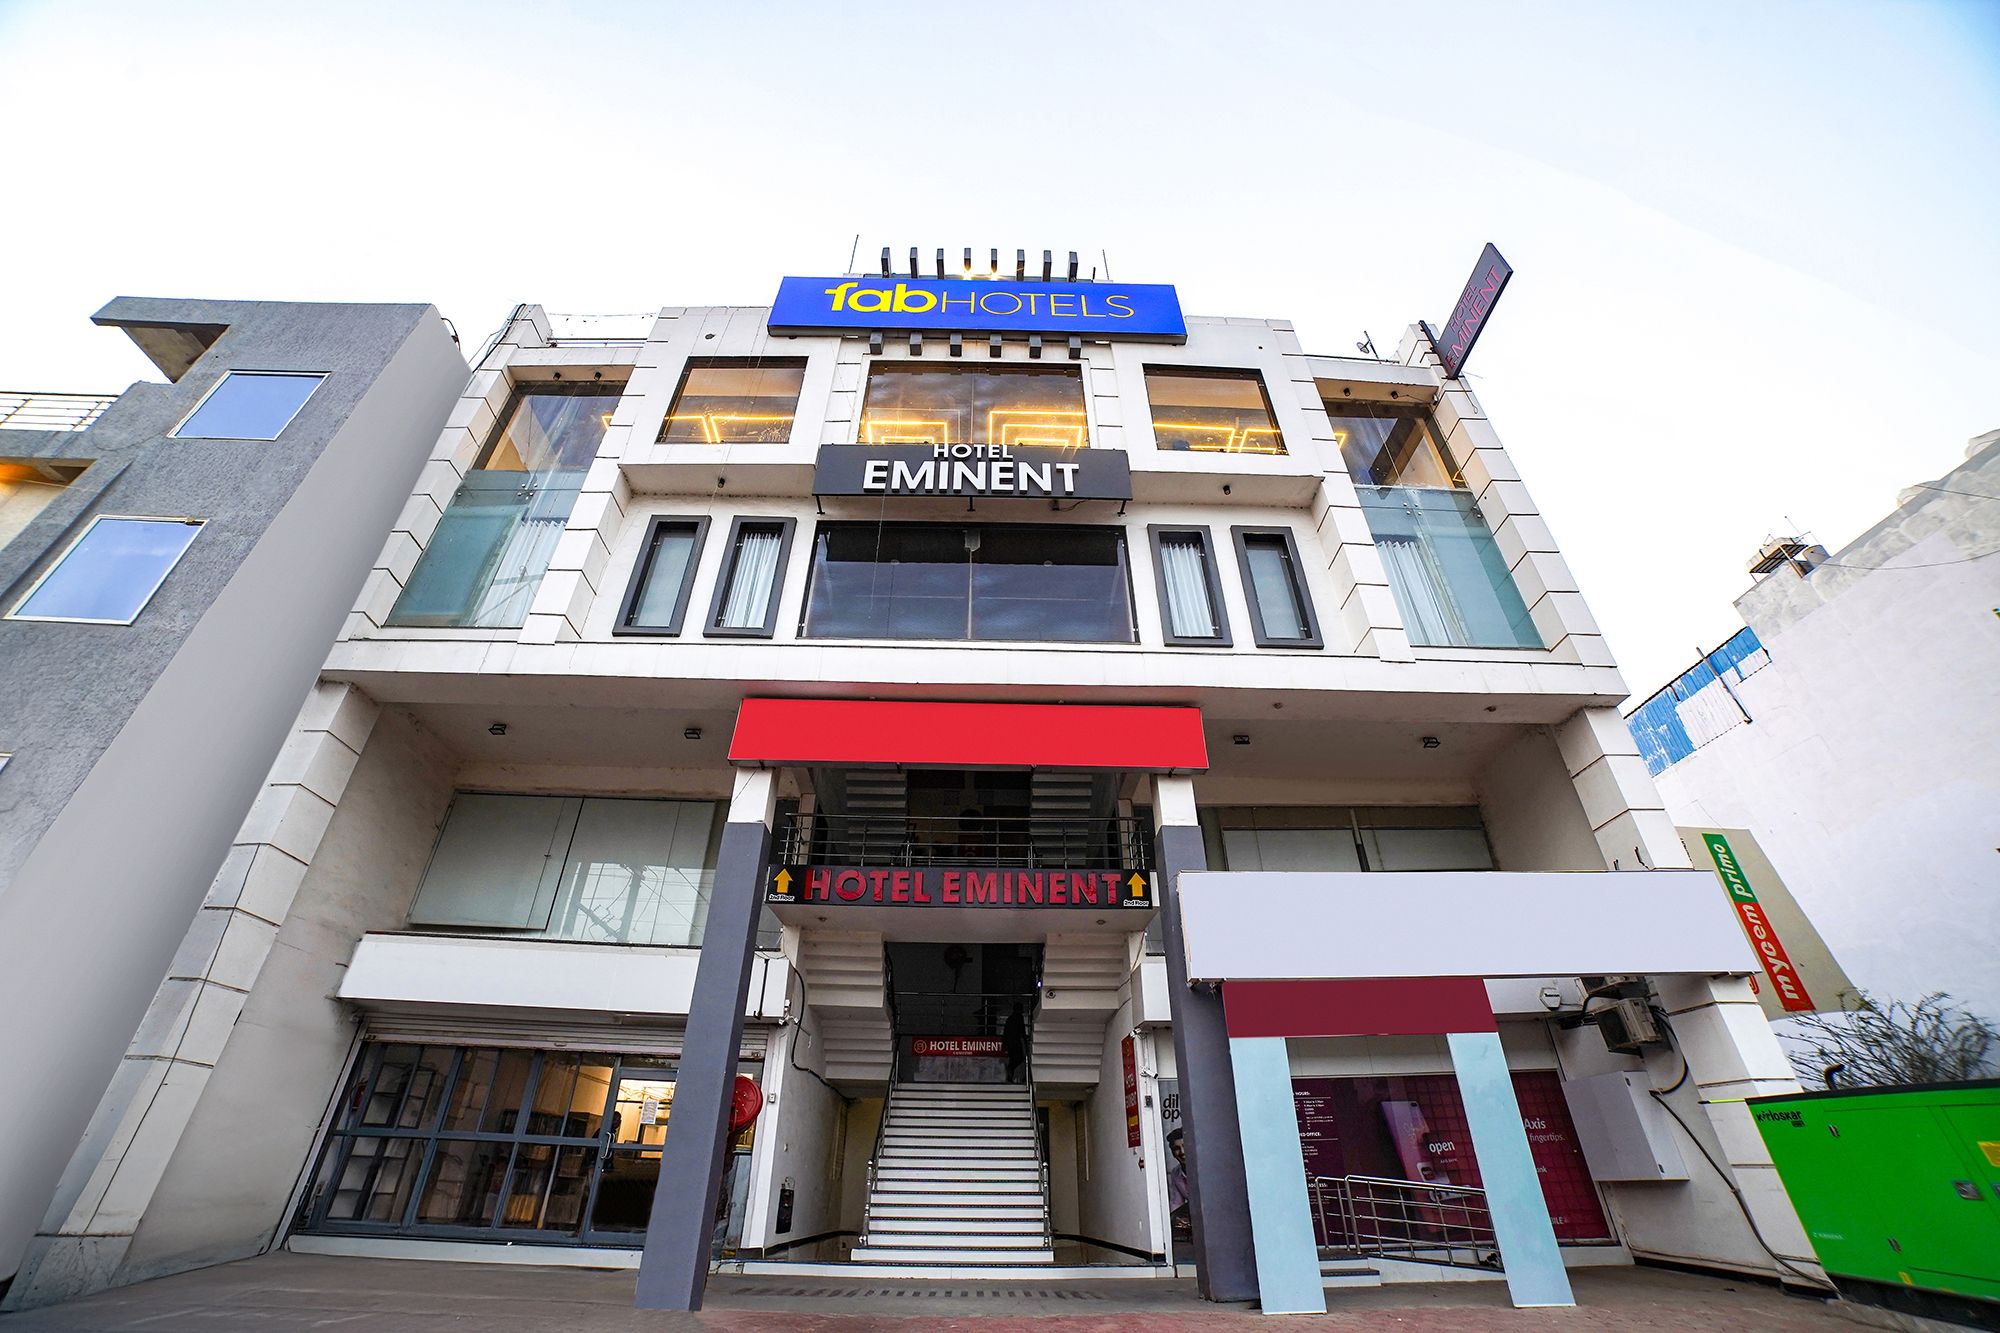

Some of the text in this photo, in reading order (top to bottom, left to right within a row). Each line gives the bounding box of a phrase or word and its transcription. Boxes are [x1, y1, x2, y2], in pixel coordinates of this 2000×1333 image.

[1445, 264, 1501, 369] EMINENT
[933, 443, 1013, 459] HOTEL
[863, 459, 1079, 495] EMINENT
[804, 868, 1122, 905] HOTEL EMINENT
[1713, 843, 1800, 1000] mycem primo
[930, 1041, 1003, 1051] HOTEL EMINENT
[1163, 1094, 1179, 1109] dil
[1524, 1118, 1546, 1129] Axis
[1429, 1141, 1455, 1155] open
